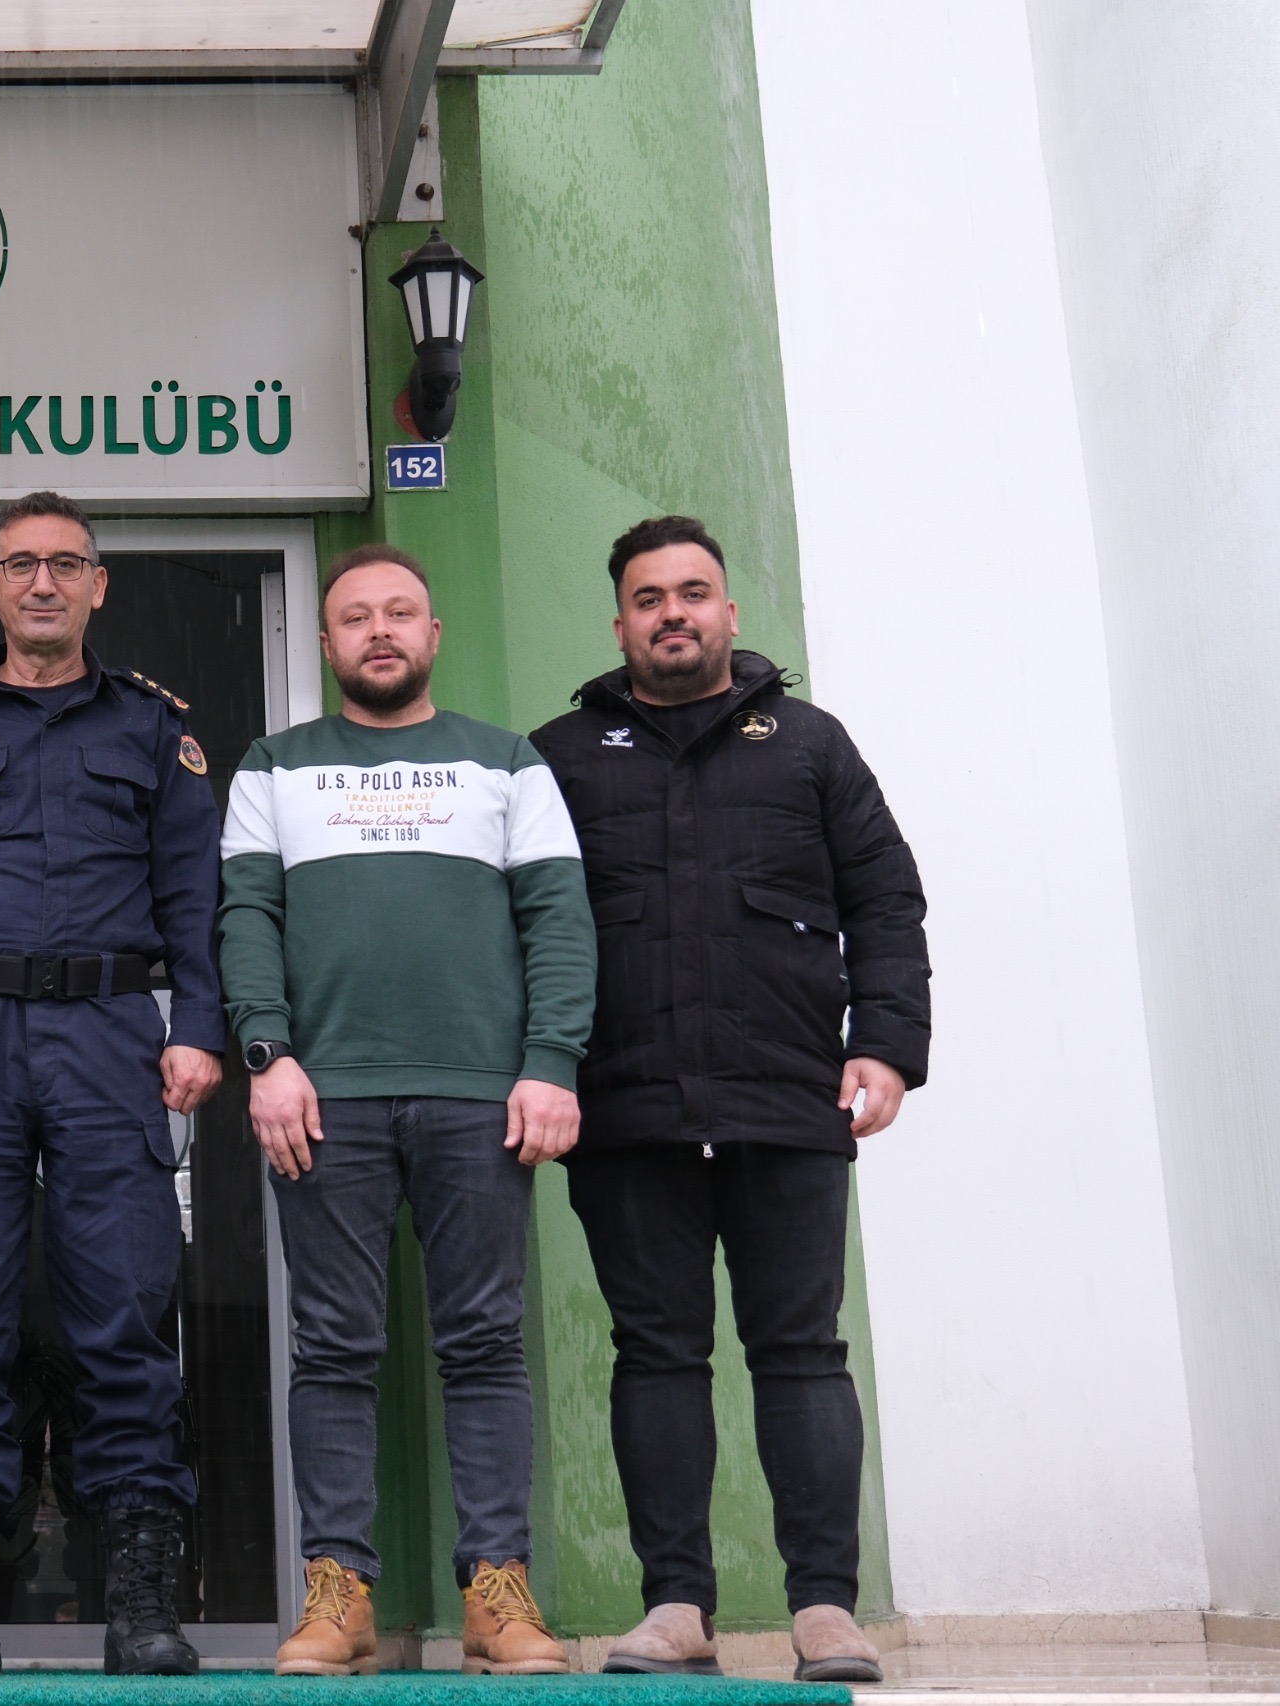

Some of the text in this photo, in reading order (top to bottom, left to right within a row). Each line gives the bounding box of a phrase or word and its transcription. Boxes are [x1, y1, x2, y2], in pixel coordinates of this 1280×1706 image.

[390, 456, 438, 479] 152
[317, 770, 465, 790] U.S. POLO ASSN.
[344, 791, 437, 803] TRADITION OF
[349, 802, 431, 813] EXCELLENCE
[327, 812, 454, 828] Authentic Clothing Brand
[360, 828, 420, 841] SINCE 1890
